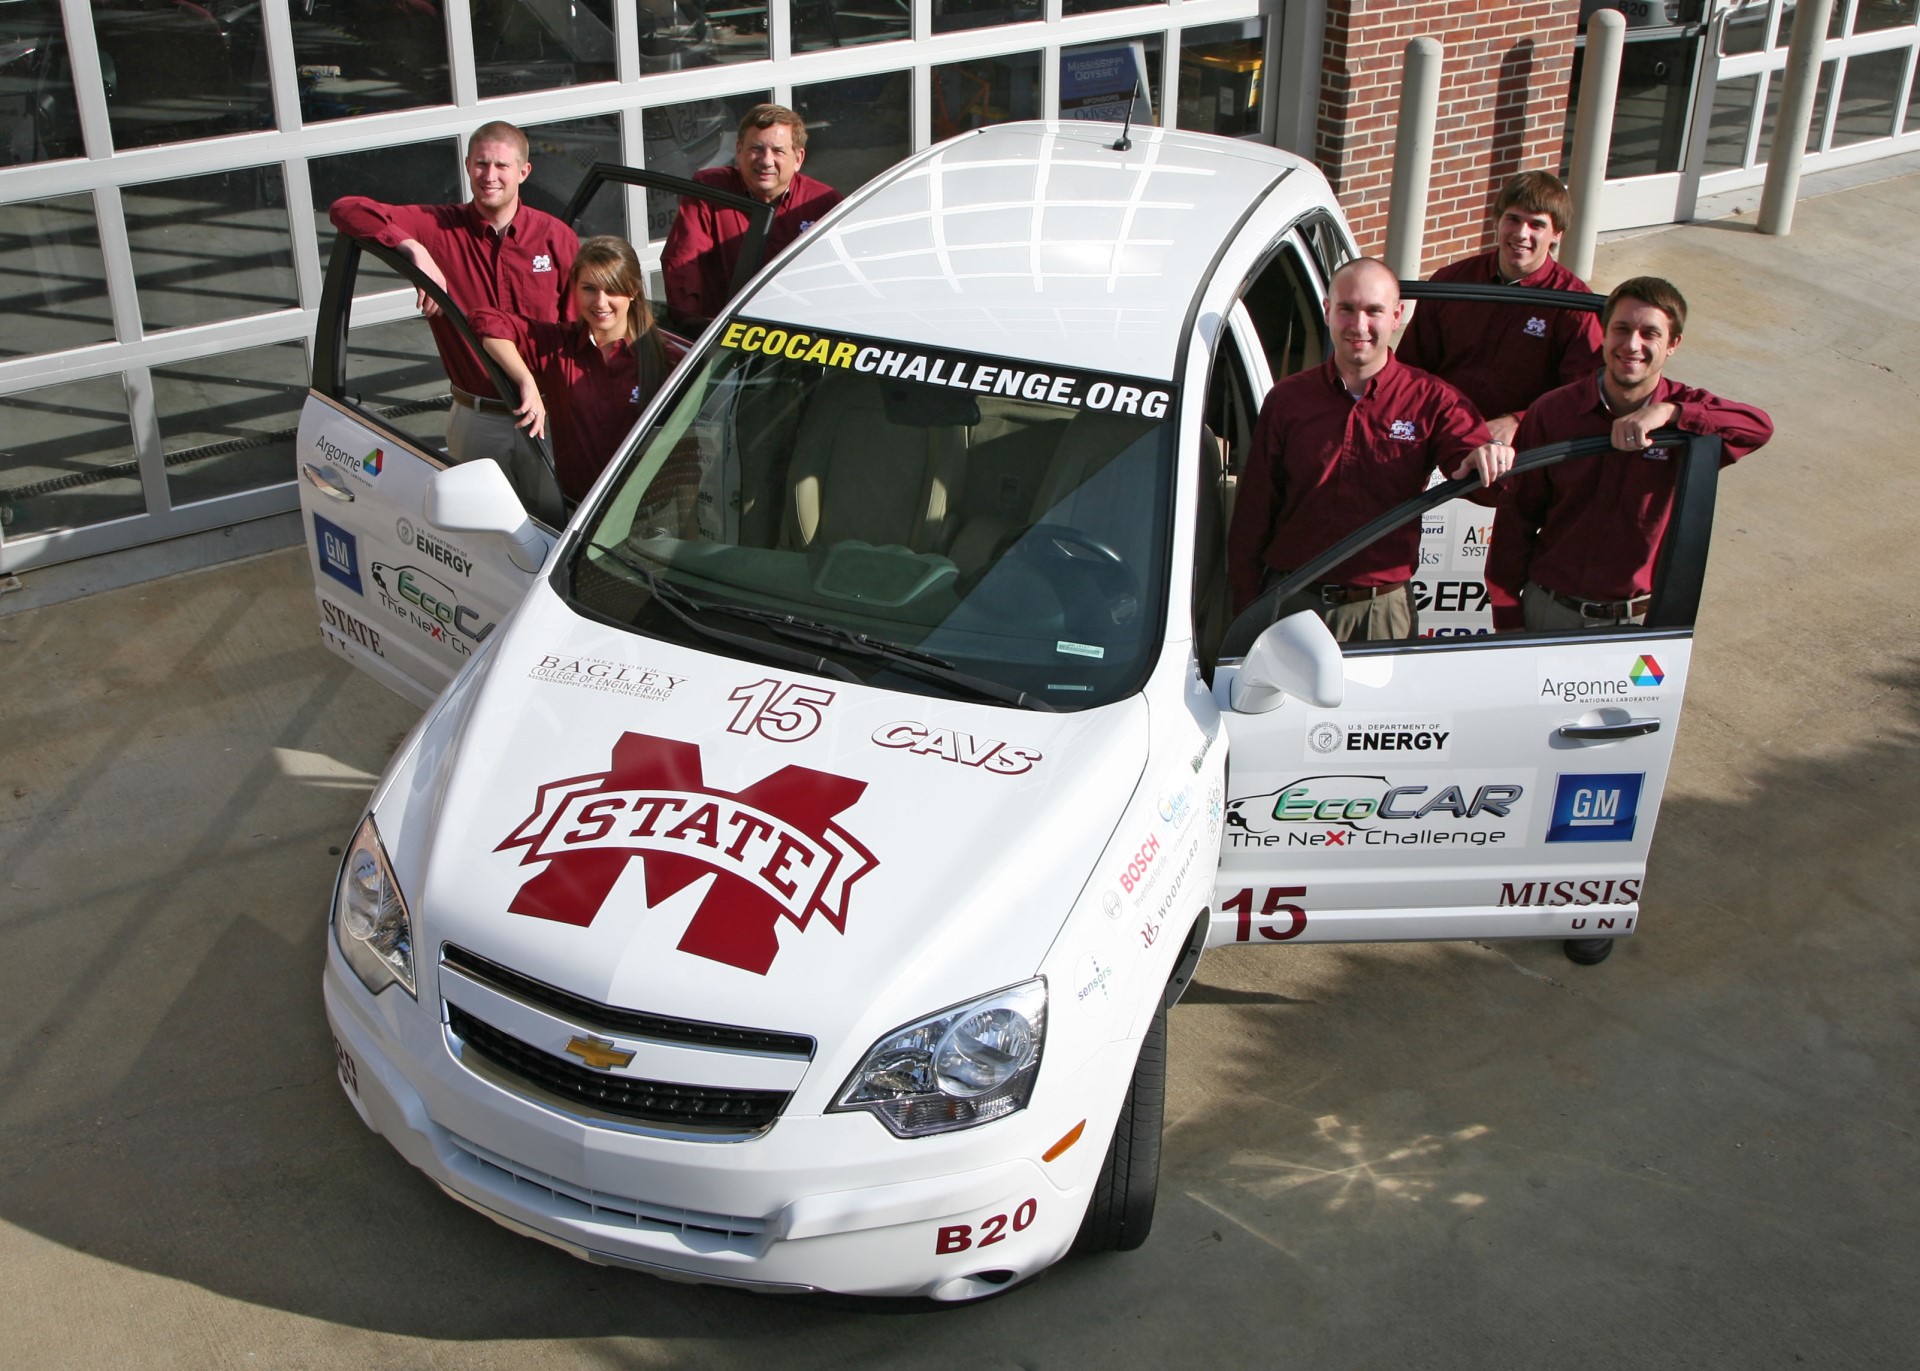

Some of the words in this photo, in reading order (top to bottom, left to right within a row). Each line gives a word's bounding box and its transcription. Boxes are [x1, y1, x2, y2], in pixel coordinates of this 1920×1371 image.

[720, 322, 1169, 419] ECOCARCHALLENGE.ORG
[315, 434, 361, 472] Argonne
[324, 531, 349, 568] GM
[417, 533, 473, 578] ENERGY
[427, 532, 460, 553] DEPARTMENT
[1418, 547, 1440, 565] ks
[378, 591, 407, 618] The
[322, 599, 385, 658] STATE
[531, 666, 576, 681] COLLEGE
[579, 674, 594, 684] OF
[596, 677, 673, 698] ENGINEERING
[537, 654, 688, 690] BAGLEY
[579, 655, 614, 666] JAMES
[619, 662, 658, 673] WORTH
[526, 673, 581, 687] MISSISSIPPI
[582, 683, 609, 692] STATE
[612, 688, 667, 702] UNIVERSITY
[1541, 678, 1628, 702] Argonne
[726, 677, 837, 743] 15
[871, 720, 1043, 776] CAVS
[1346, 732, 1450, 751] ENERGY
[1271, 783, 1524, 822] EcoCAR
[1573, 788, 1620, 819] GM
[563, 796, 817, 902] STATE
[1228, 832, 1280, 848] The
[1365, 829, 1506, 847] Challenge
[1119, 832, 1160, 894] BOSCH
[1158, 839, 1198, 919] WOODWARD
[1496, 879, 1641, 908] MISSIS
[1221, 885, 1309, 942] 15
[1571, 917, 1634, 931] UNI
[1077, 965, 1112, 1001] sensors
[935, 1197, 1038, 1256] B20
